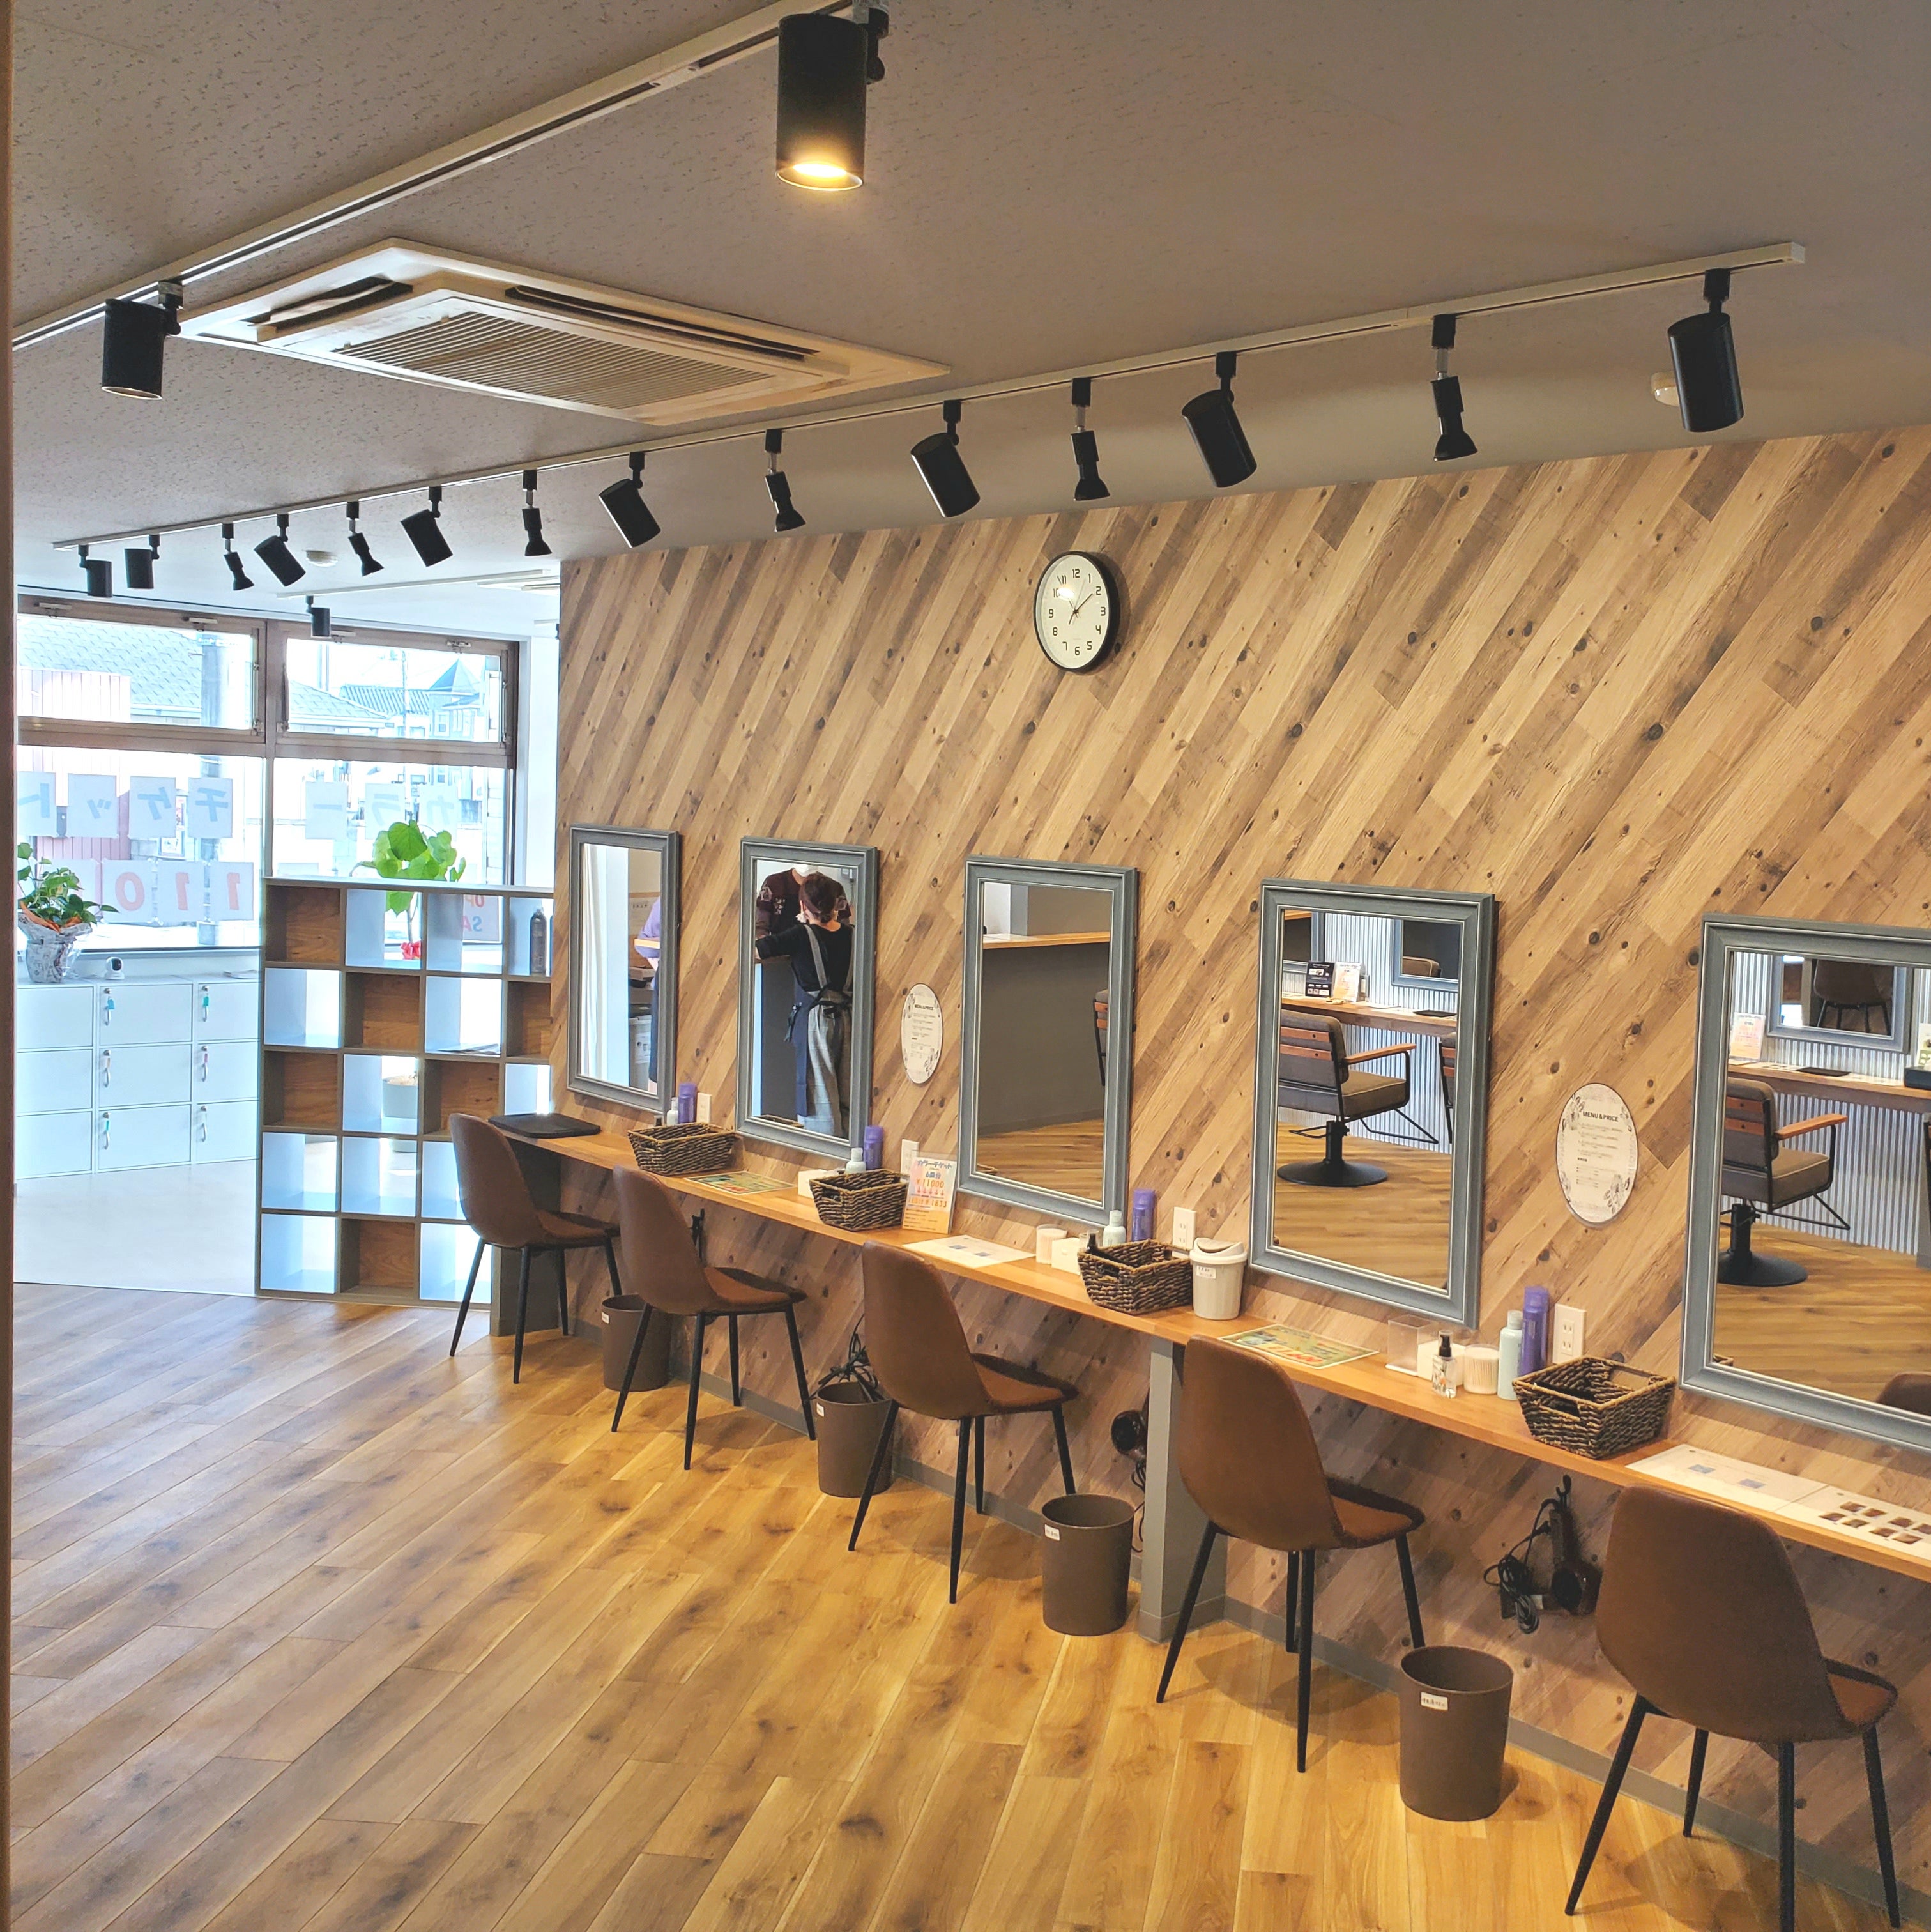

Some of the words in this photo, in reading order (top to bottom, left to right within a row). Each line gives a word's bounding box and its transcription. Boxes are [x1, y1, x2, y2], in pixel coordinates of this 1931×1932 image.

[1072, 569, 1080, 578] 12
[1061, 575, 1067, 585] 11
[1088, 574, 1091, 583] 1
[1095, 586, 1102, 595] 2
[1048, 608, 1054, 618] 9
[1100, 606, 1106, 616] 3
[1052, 627, 1058, 636] 8
[1095, 625, 1101, 635] 4
[1062, 641, 1068, 651] 7
[1087, 641, 1092, 650] 5
[1074, 647, 1080, 656] 6
[1583, 1111, 1598, 1119] MENU
[917, 1160, 952, 1169] カラーチケット
